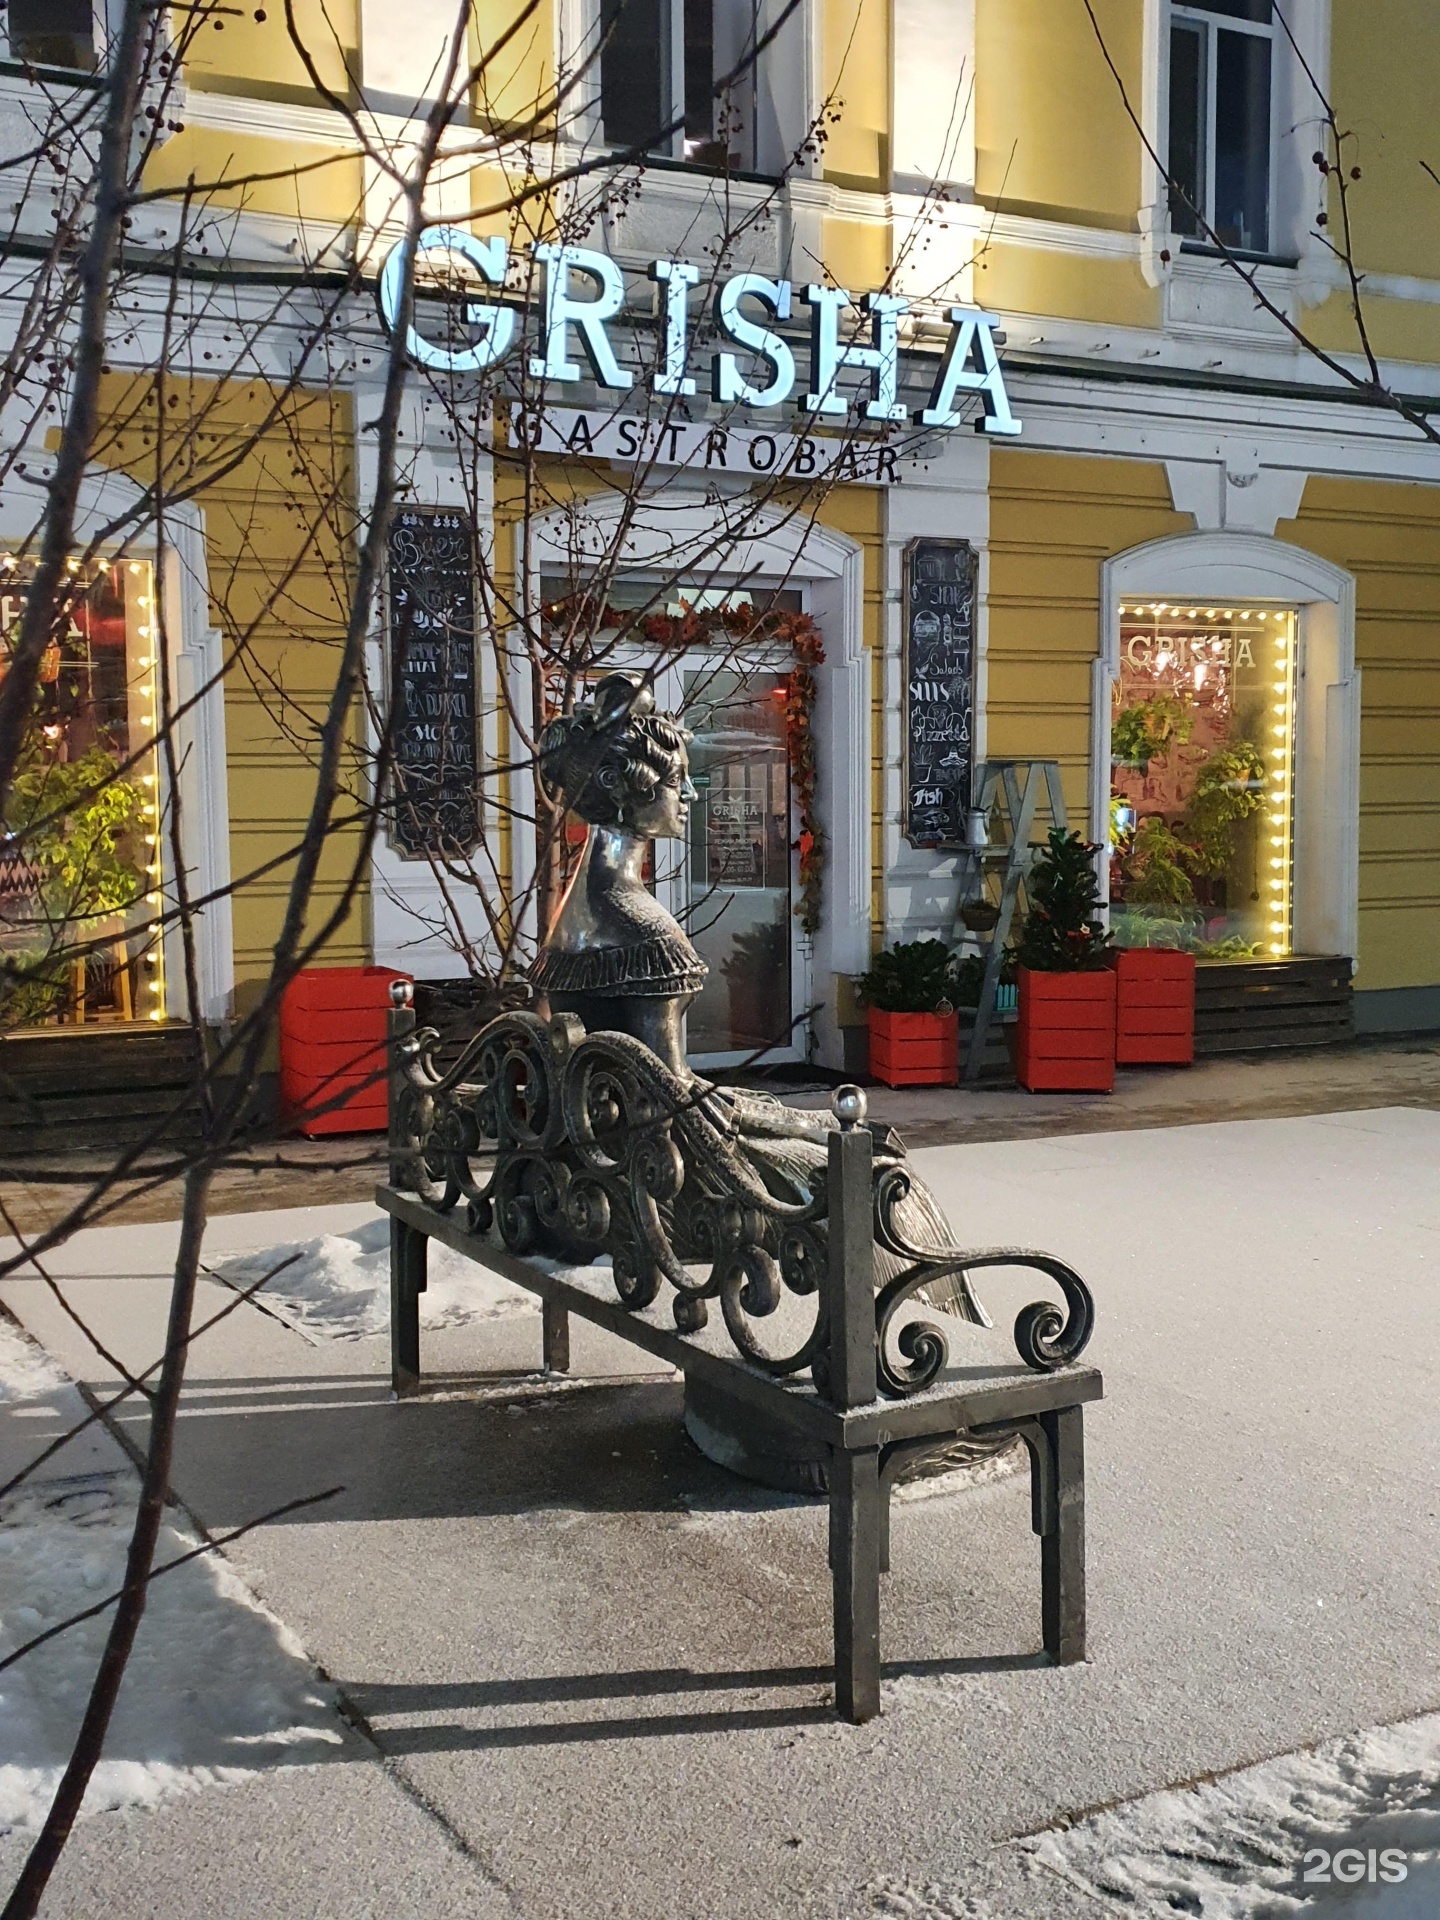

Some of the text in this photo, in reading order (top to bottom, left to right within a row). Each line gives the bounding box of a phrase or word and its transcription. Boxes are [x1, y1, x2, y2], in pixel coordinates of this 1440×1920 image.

[379, 228, 1022, 436] GRISHA
[514, 409, 904, 483] GASTROBAR
[929, 652, 963, 676] Salads
[1127, 635, 1256, 668] GRISHA
[712, 805, 758, 816] GRISHA
